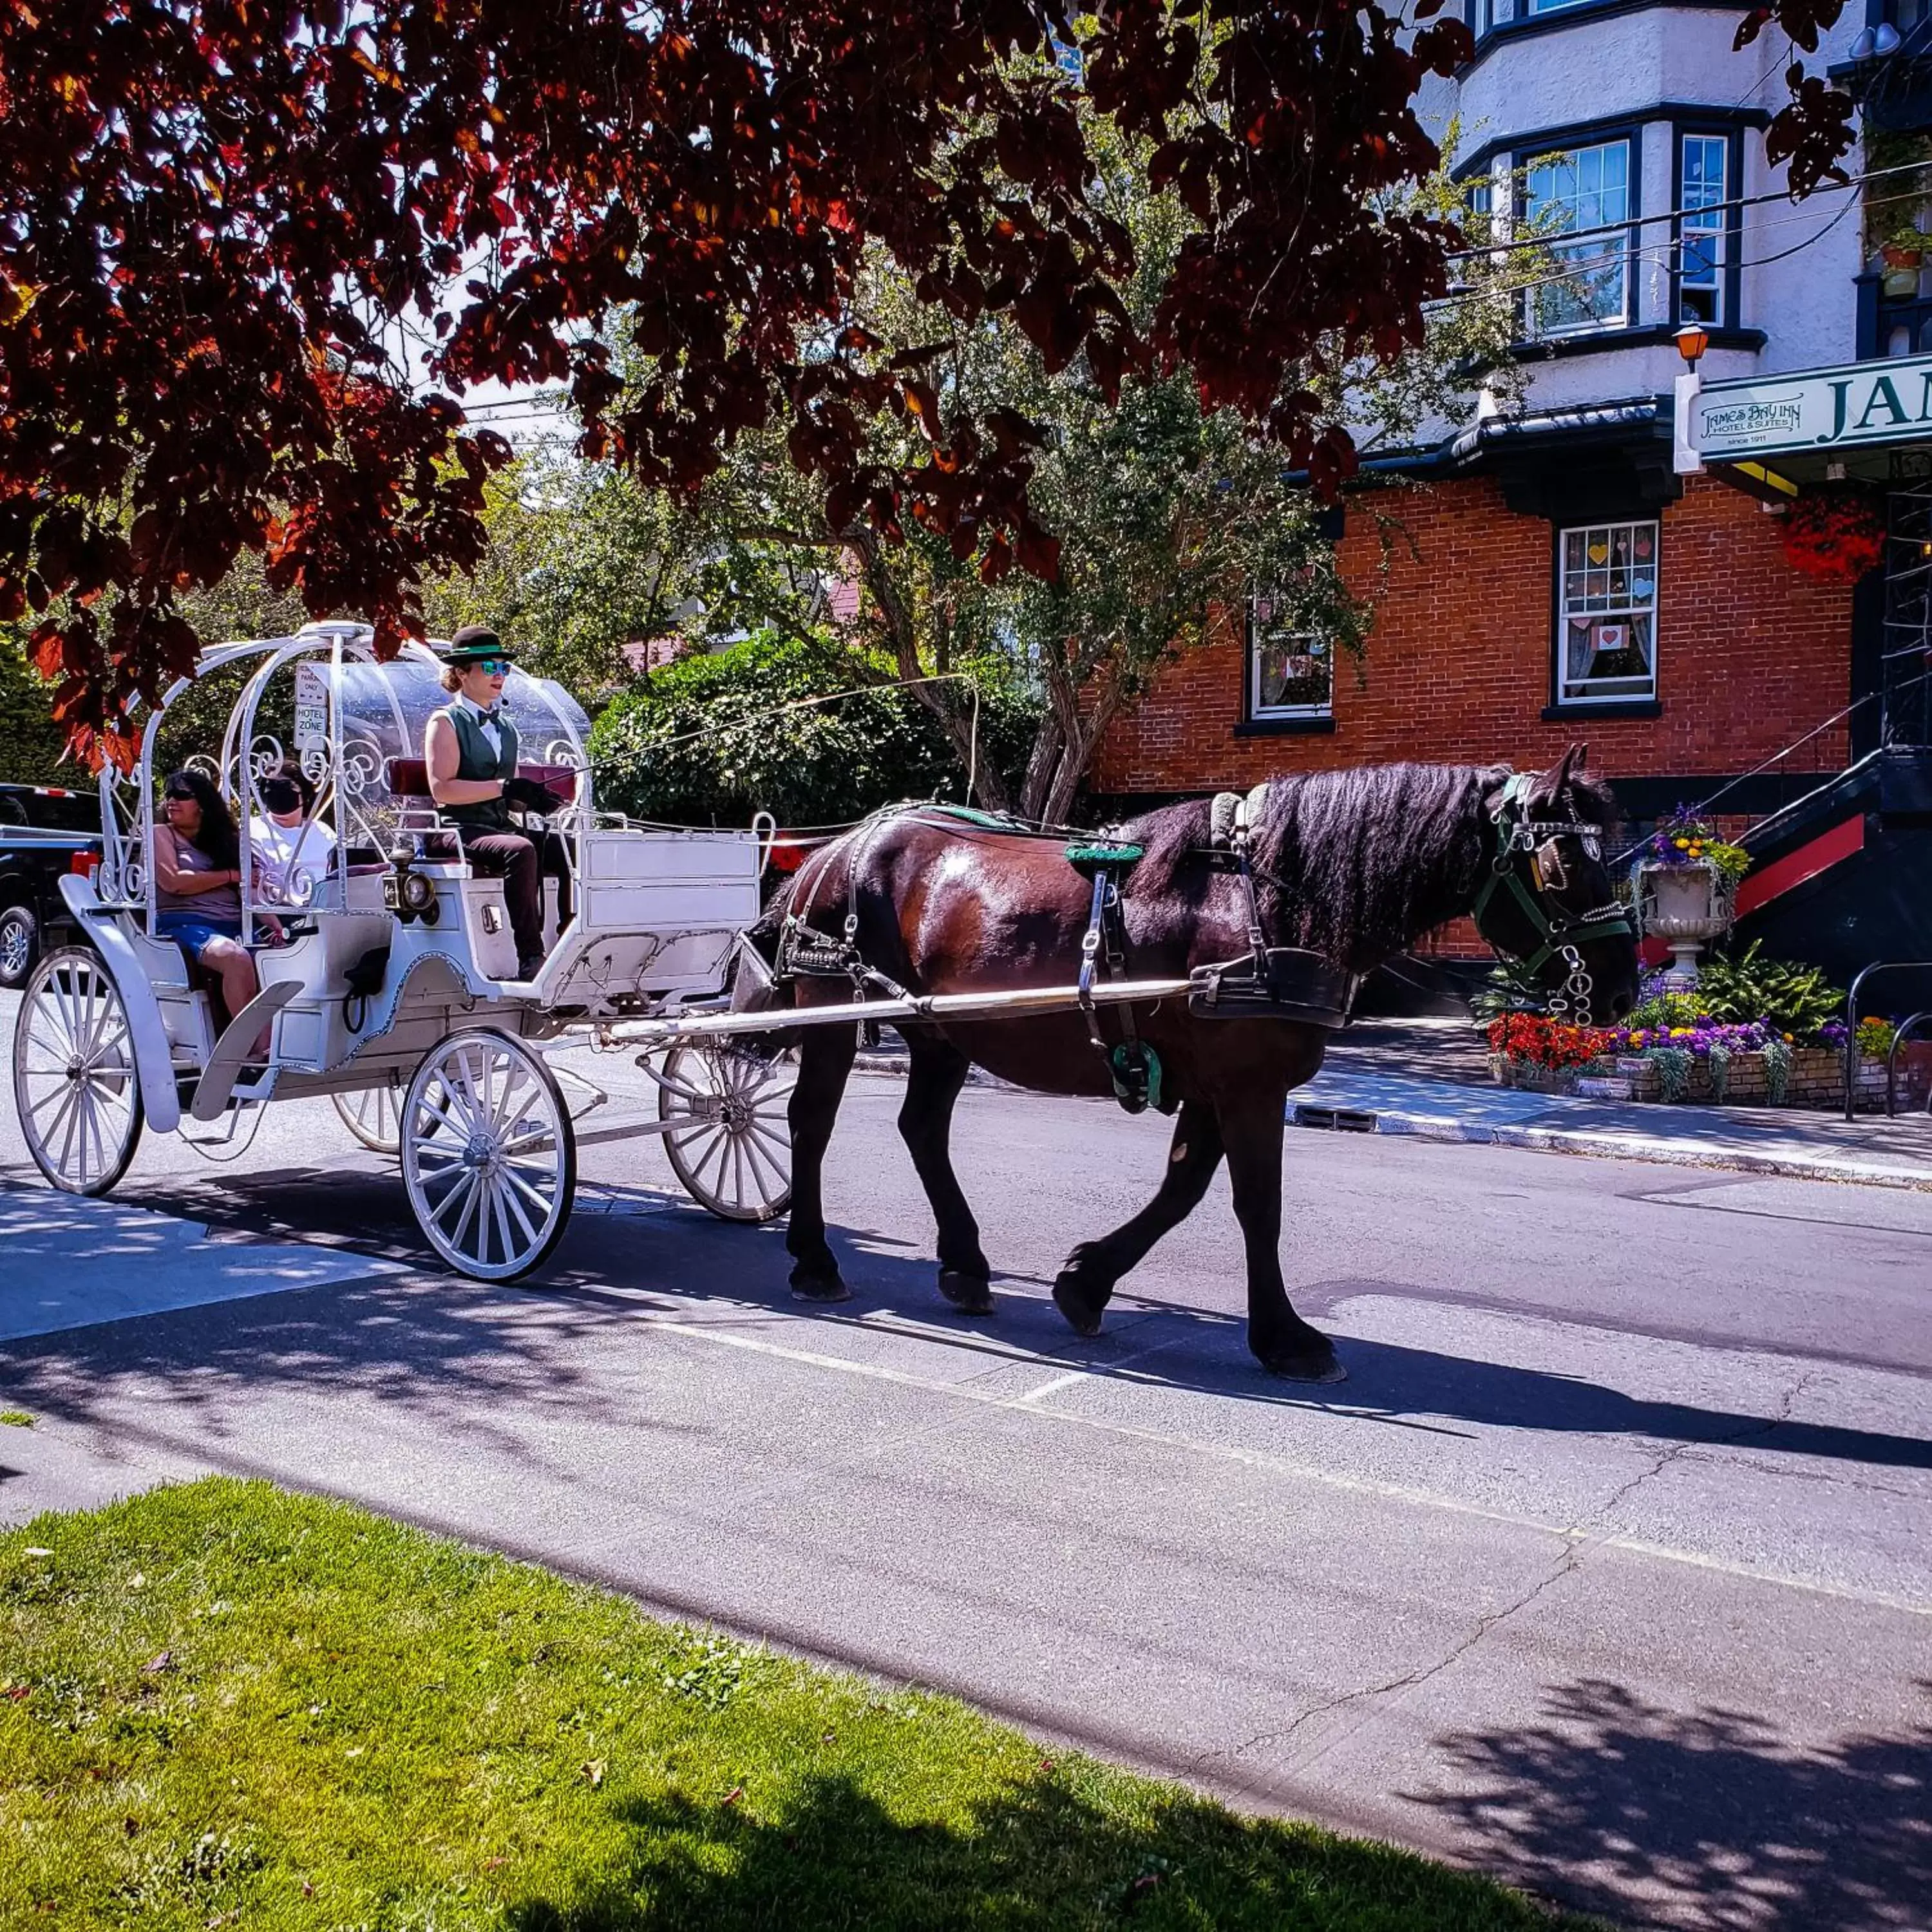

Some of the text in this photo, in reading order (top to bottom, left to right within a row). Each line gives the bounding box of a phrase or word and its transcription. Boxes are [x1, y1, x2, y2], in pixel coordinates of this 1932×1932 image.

[1816, 372, 1932, 444] JA
[1701, 404, 1801, 439] JAMES BAY INN
[1714, 422, 1745, 433] HOTEL
[1755, 419, 1788, 428] SUITES
[298, 709, 324, 719] HOTEL
[299, 721, 323, 731] ZONE
